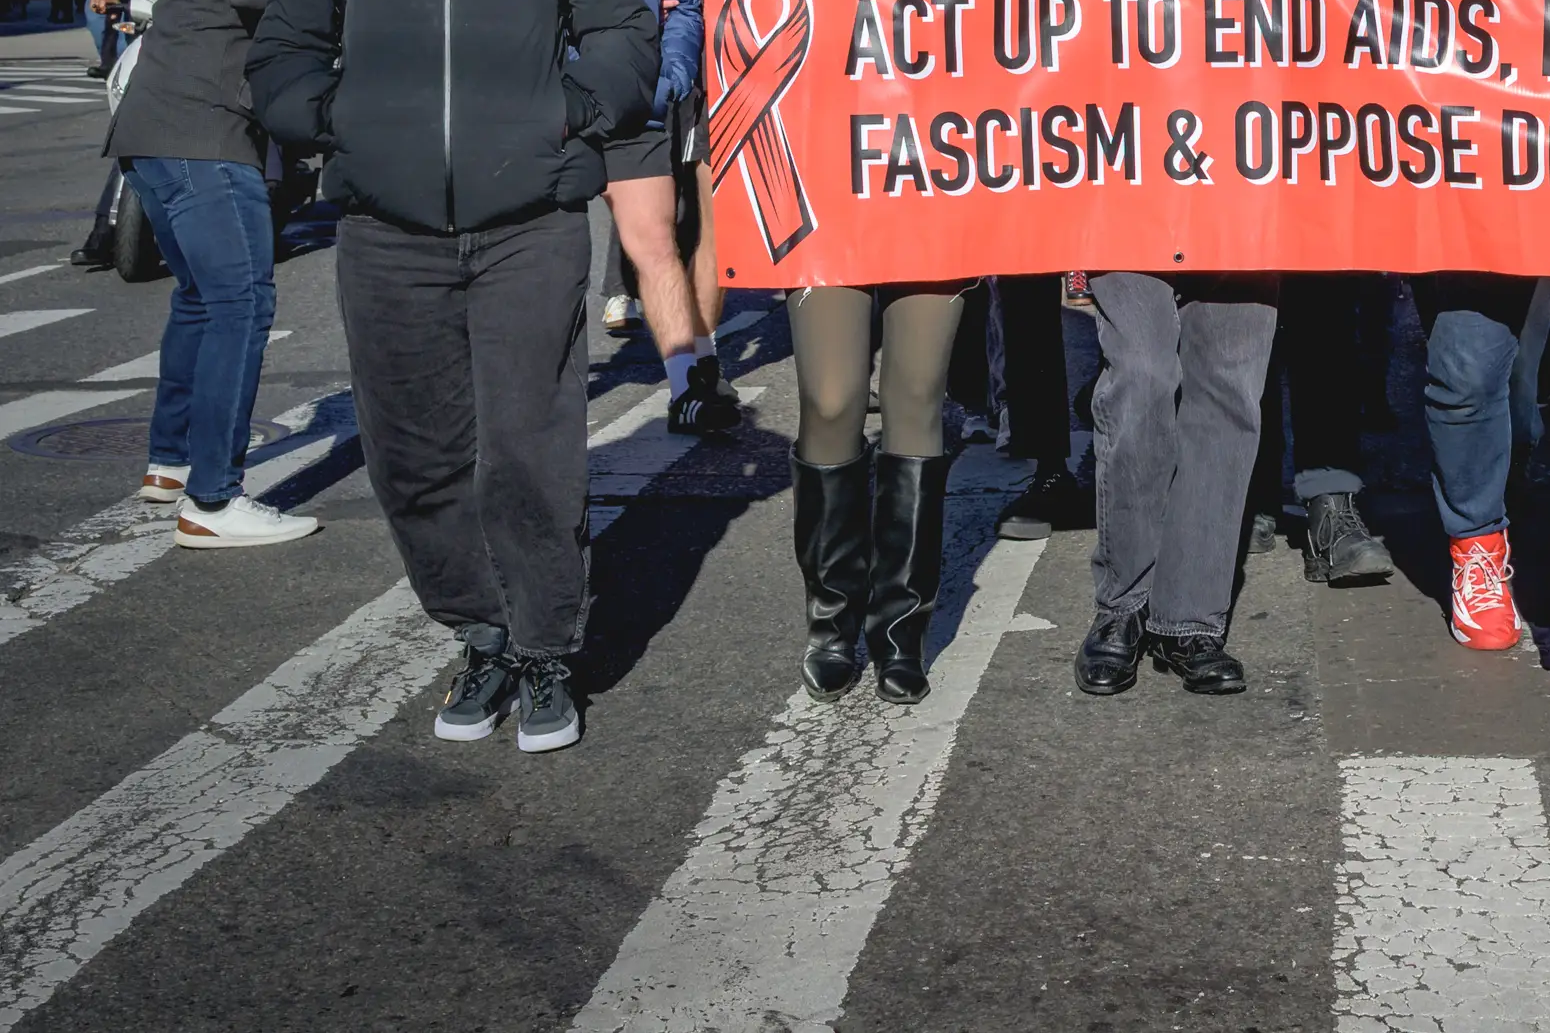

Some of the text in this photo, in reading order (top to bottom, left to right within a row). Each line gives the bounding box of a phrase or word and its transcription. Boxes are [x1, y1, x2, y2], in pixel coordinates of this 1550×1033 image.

[850, 103, 1141, 198] FASCISM
[1163, 109, 1214, 186] &
[1235, 100, 1482, 190] OPPOSE
